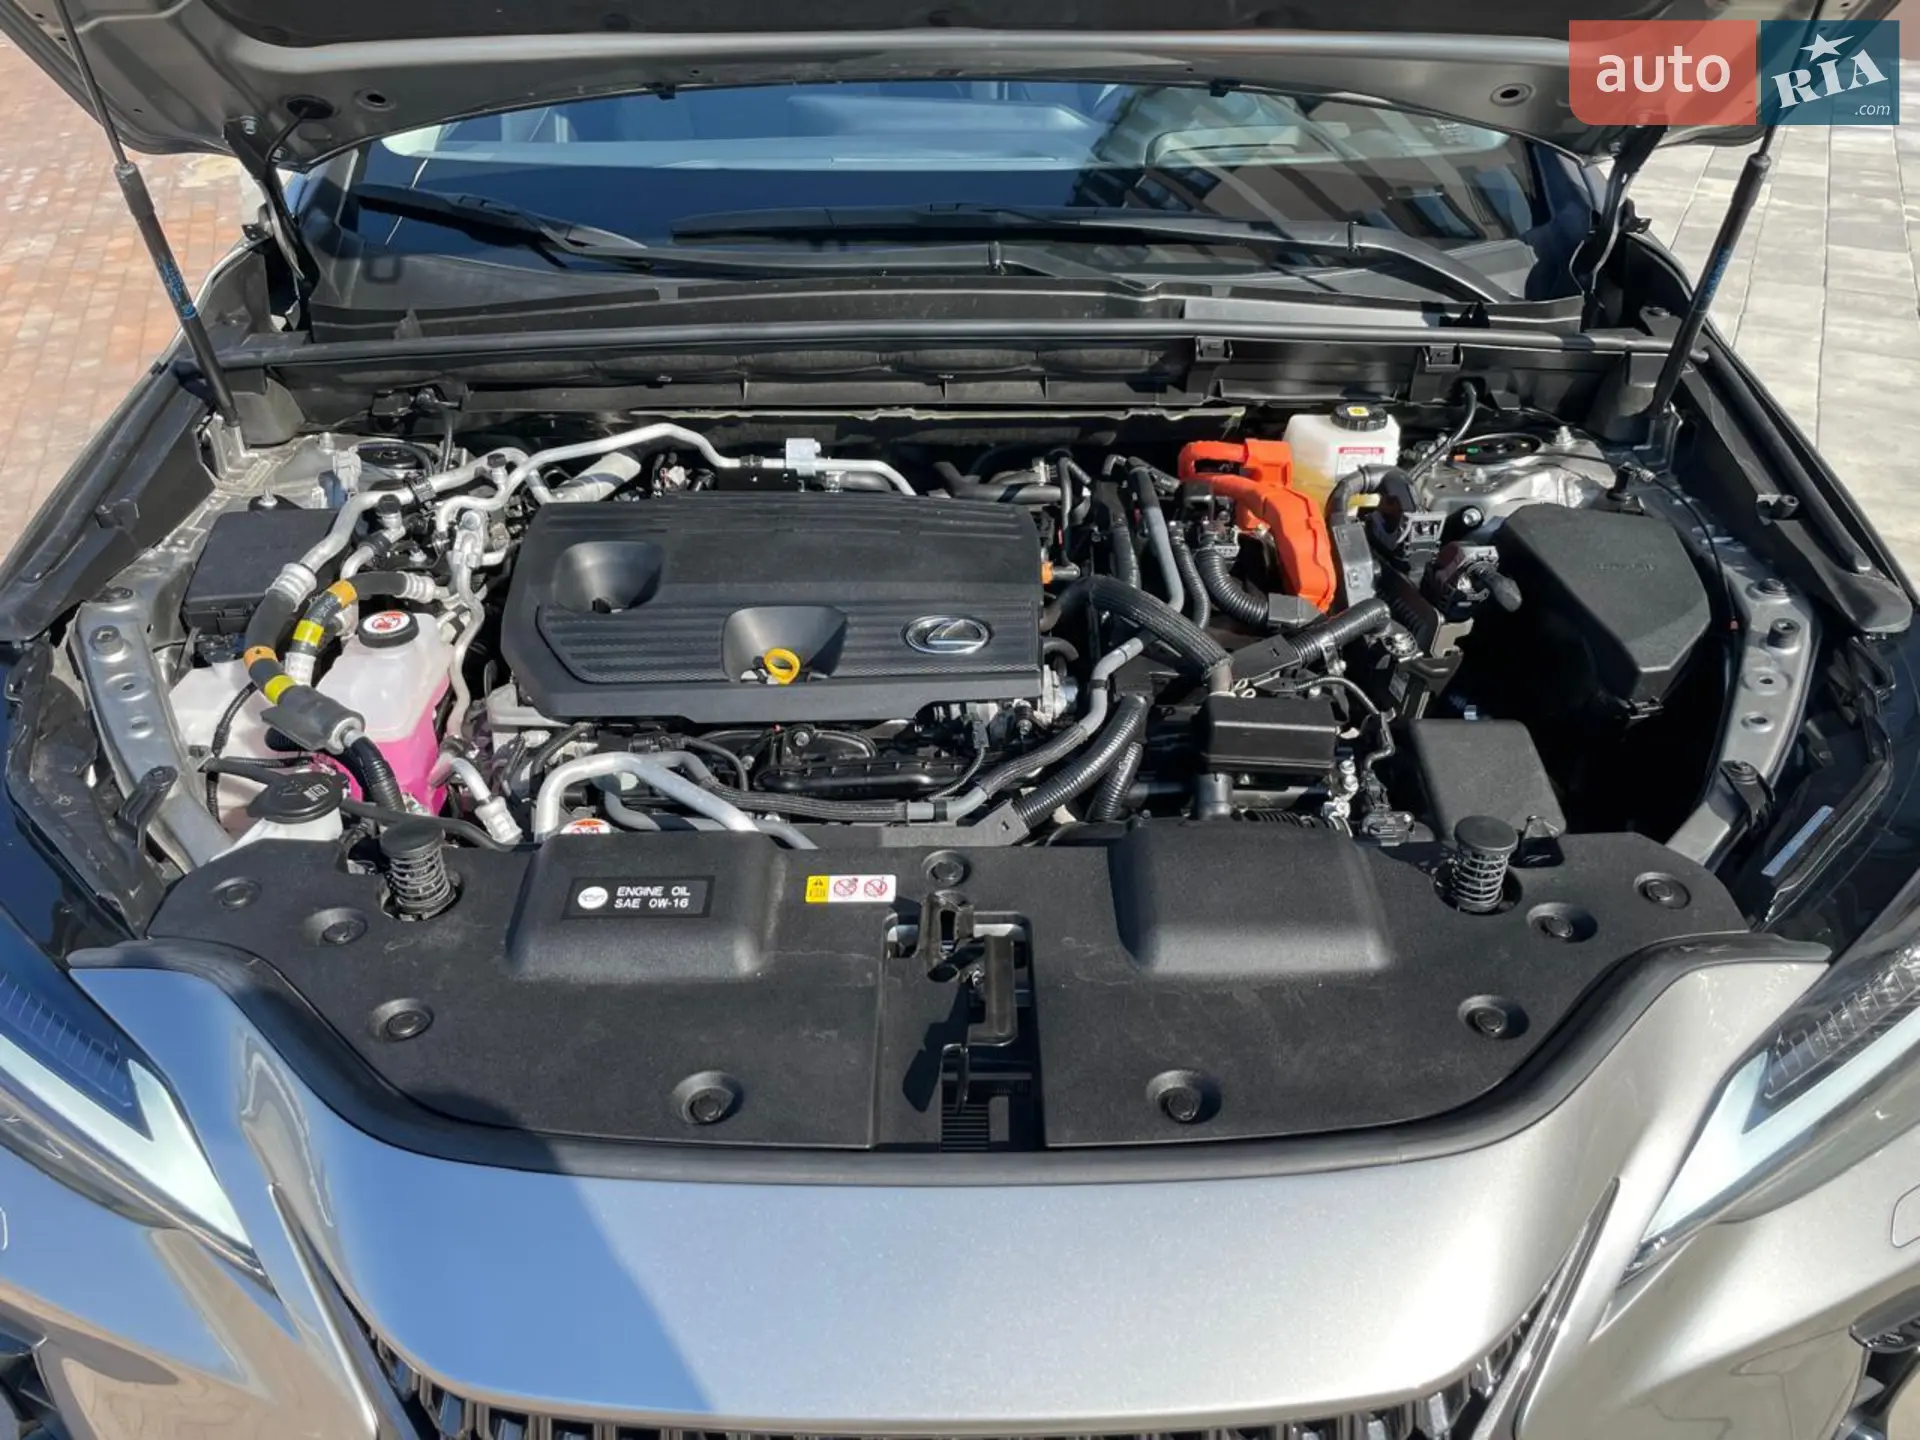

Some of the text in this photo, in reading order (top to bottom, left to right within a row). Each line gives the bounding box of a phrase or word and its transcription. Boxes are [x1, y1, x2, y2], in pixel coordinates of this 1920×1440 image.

[616, 886, 691, 897] ENGINE OIL
[614, 898, 642, 909] SAE
